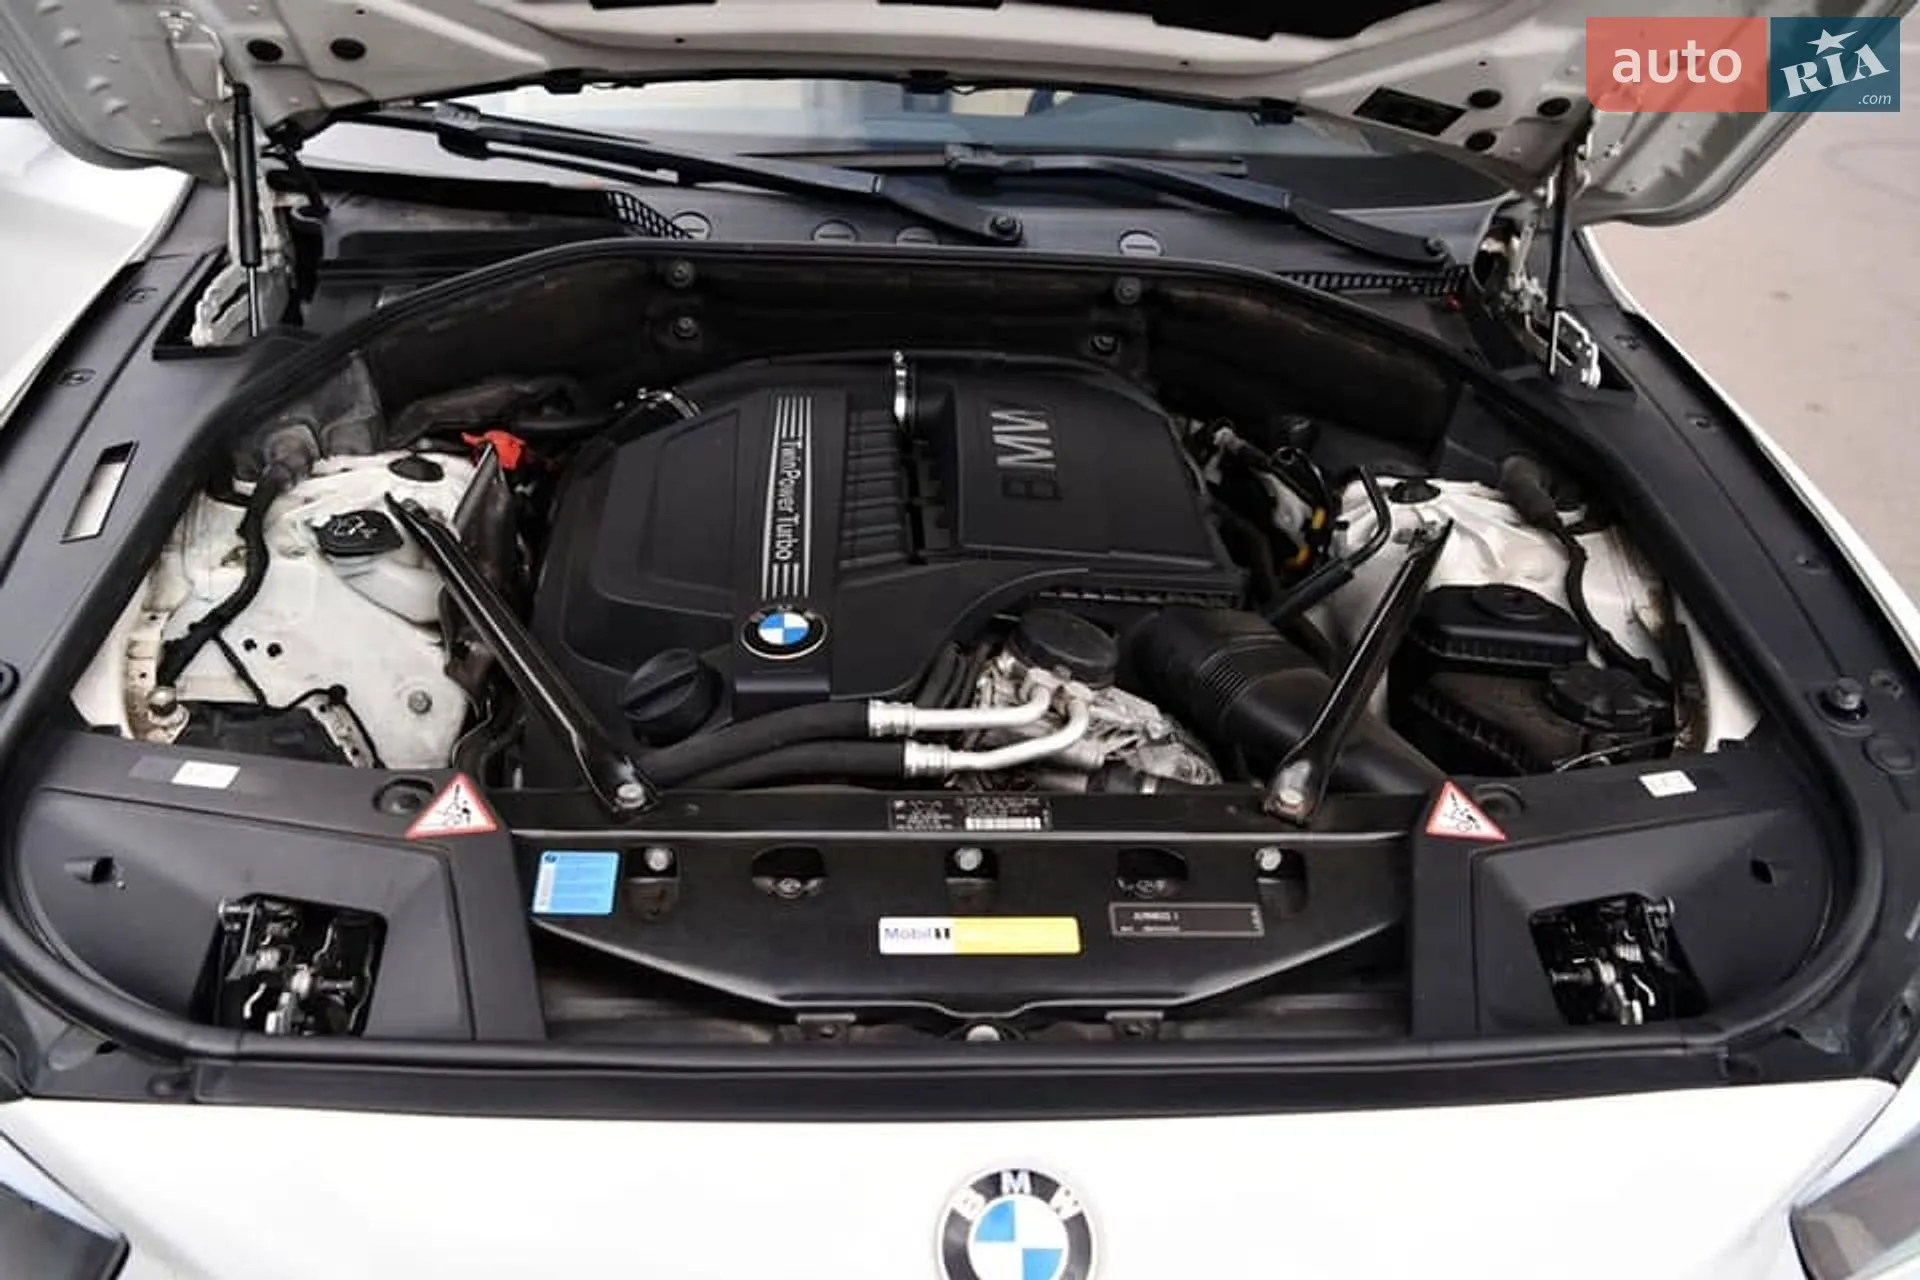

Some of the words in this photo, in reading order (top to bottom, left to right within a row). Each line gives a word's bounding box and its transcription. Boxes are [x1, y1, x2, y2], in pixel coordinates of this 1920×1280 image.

[776, 441, 803, 512] TwinPower
[991, 409, 1063, 500] BMW
[775, 513, 800, 560] Turbo
[951, 1168, 1083, 1221] BMW
